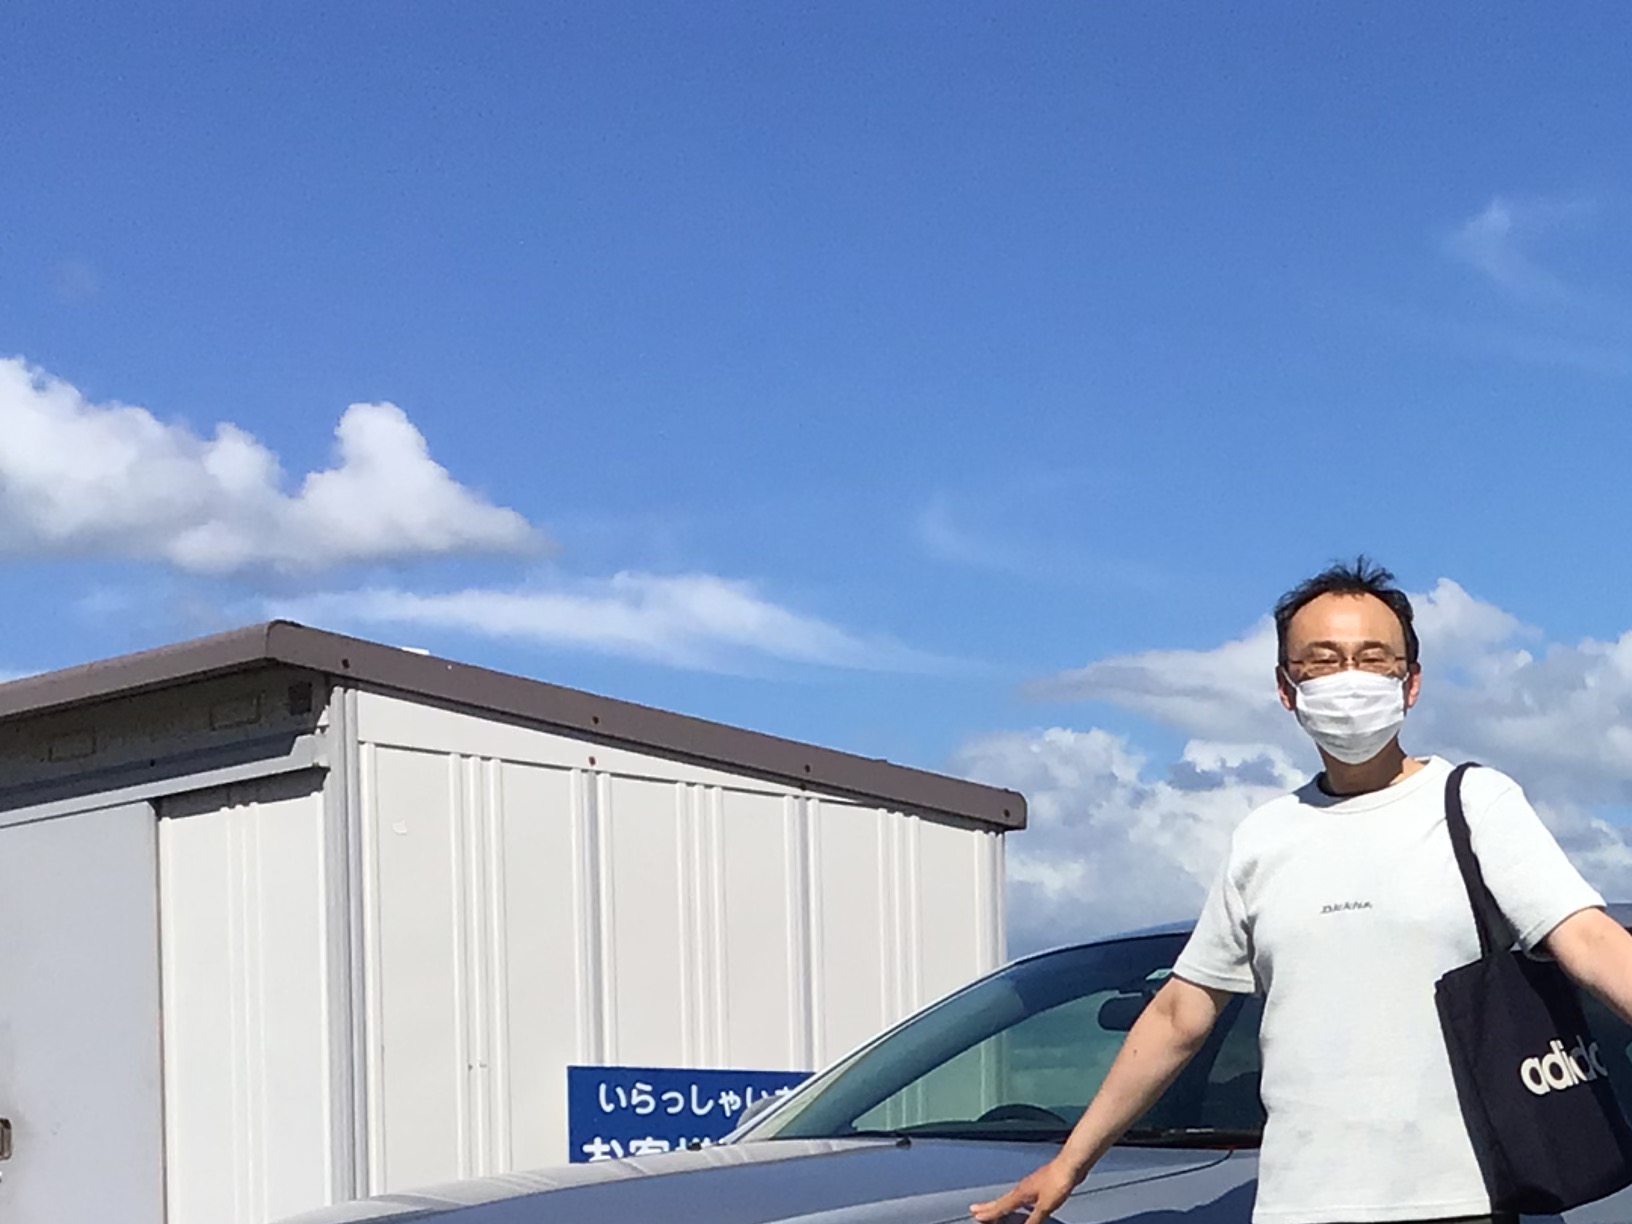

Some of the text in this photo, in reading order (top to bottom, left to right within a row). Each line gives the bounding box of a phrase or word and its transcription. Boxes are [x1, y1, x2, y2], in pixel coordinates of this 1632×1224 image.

[598, 1082, 796, 1117] いらっしゃい
